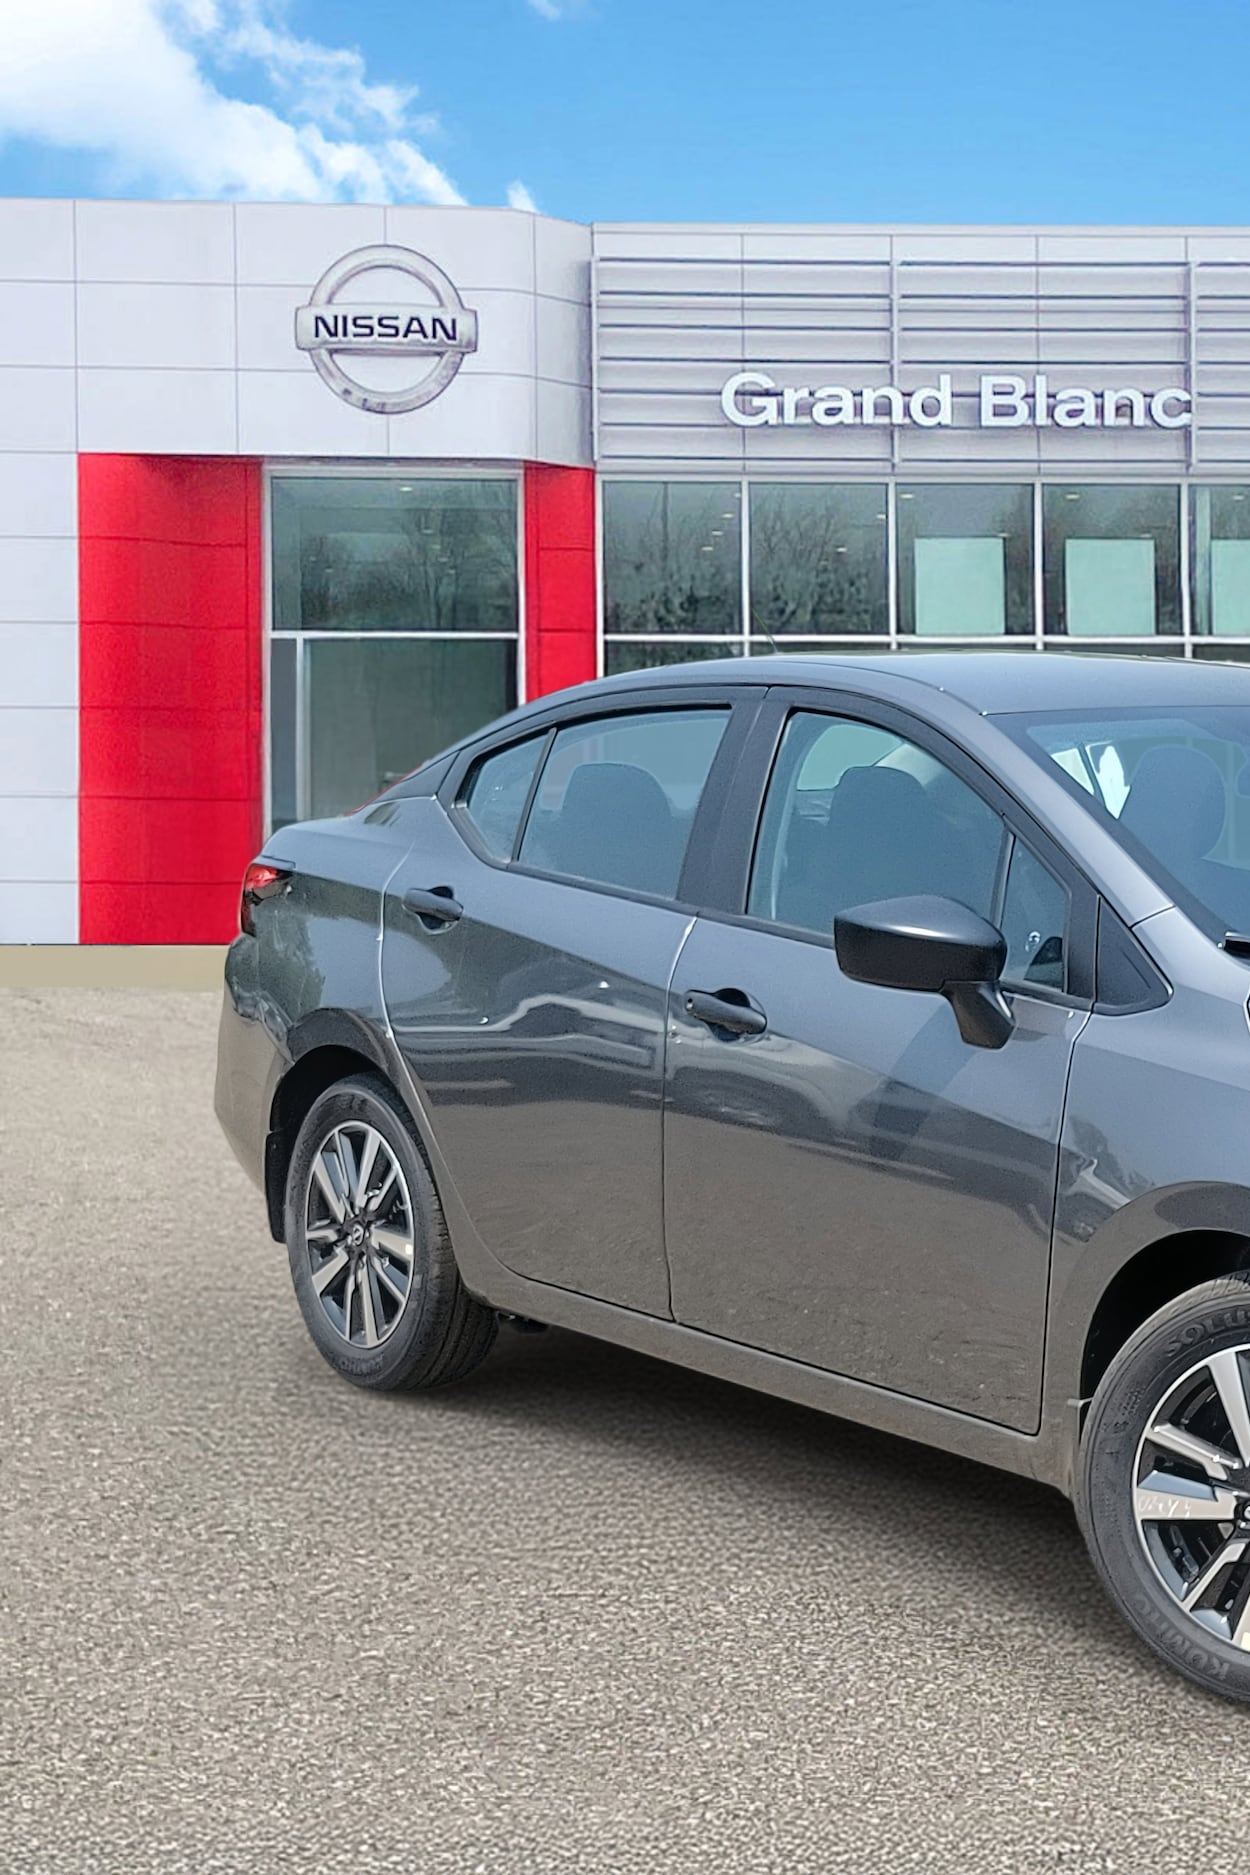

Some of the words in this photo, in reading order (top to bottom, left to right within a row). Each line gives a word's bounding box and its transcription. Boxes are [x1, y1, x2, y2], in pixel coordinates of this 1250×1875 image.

[314, 314, 458, 342] NISSAN
[720, 371, 954, 428] Grand
[978, 373, 1194, 430] Blanc
